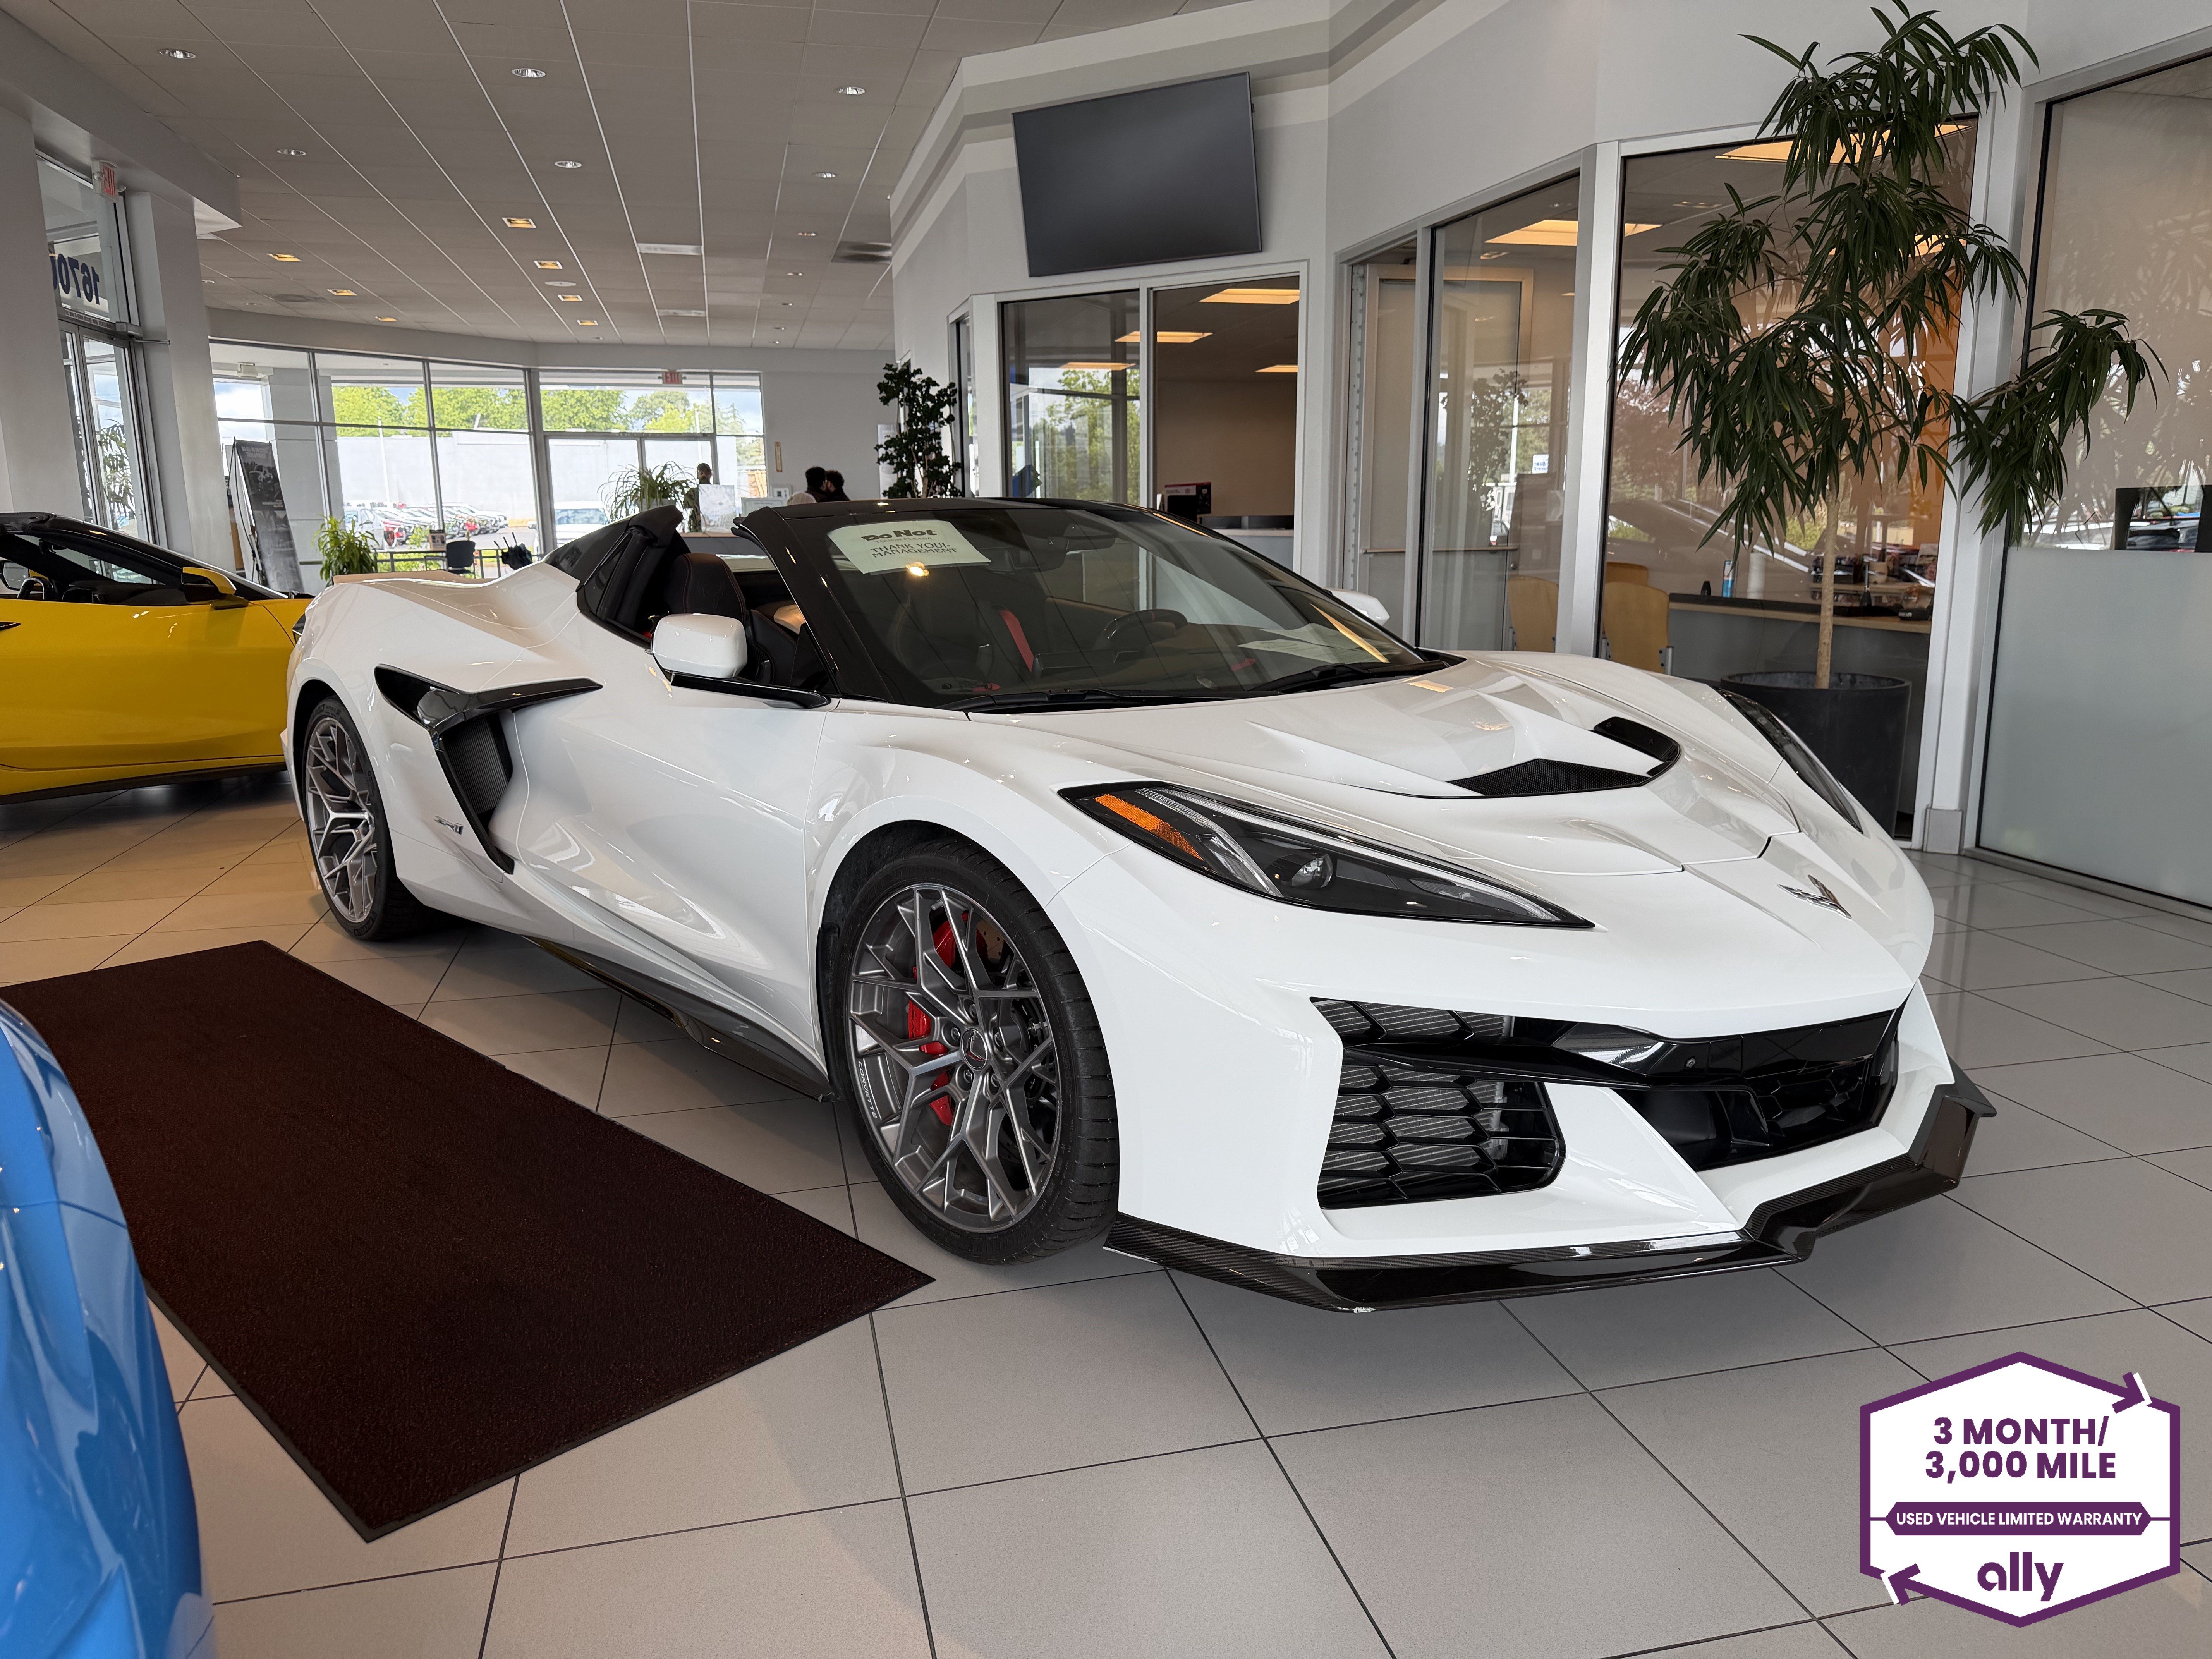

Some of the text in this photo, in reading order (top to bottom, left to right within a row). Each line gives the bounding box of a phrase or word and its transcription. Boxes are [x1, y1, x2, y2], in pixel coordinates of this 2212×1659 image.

[665, 371, 680, 384] EXIT
[870, 544, 915, 552] THANK
[872, 548, 957, 558] MANAGEMENT
[858, 1061, 878, 1119] CORVETTE
